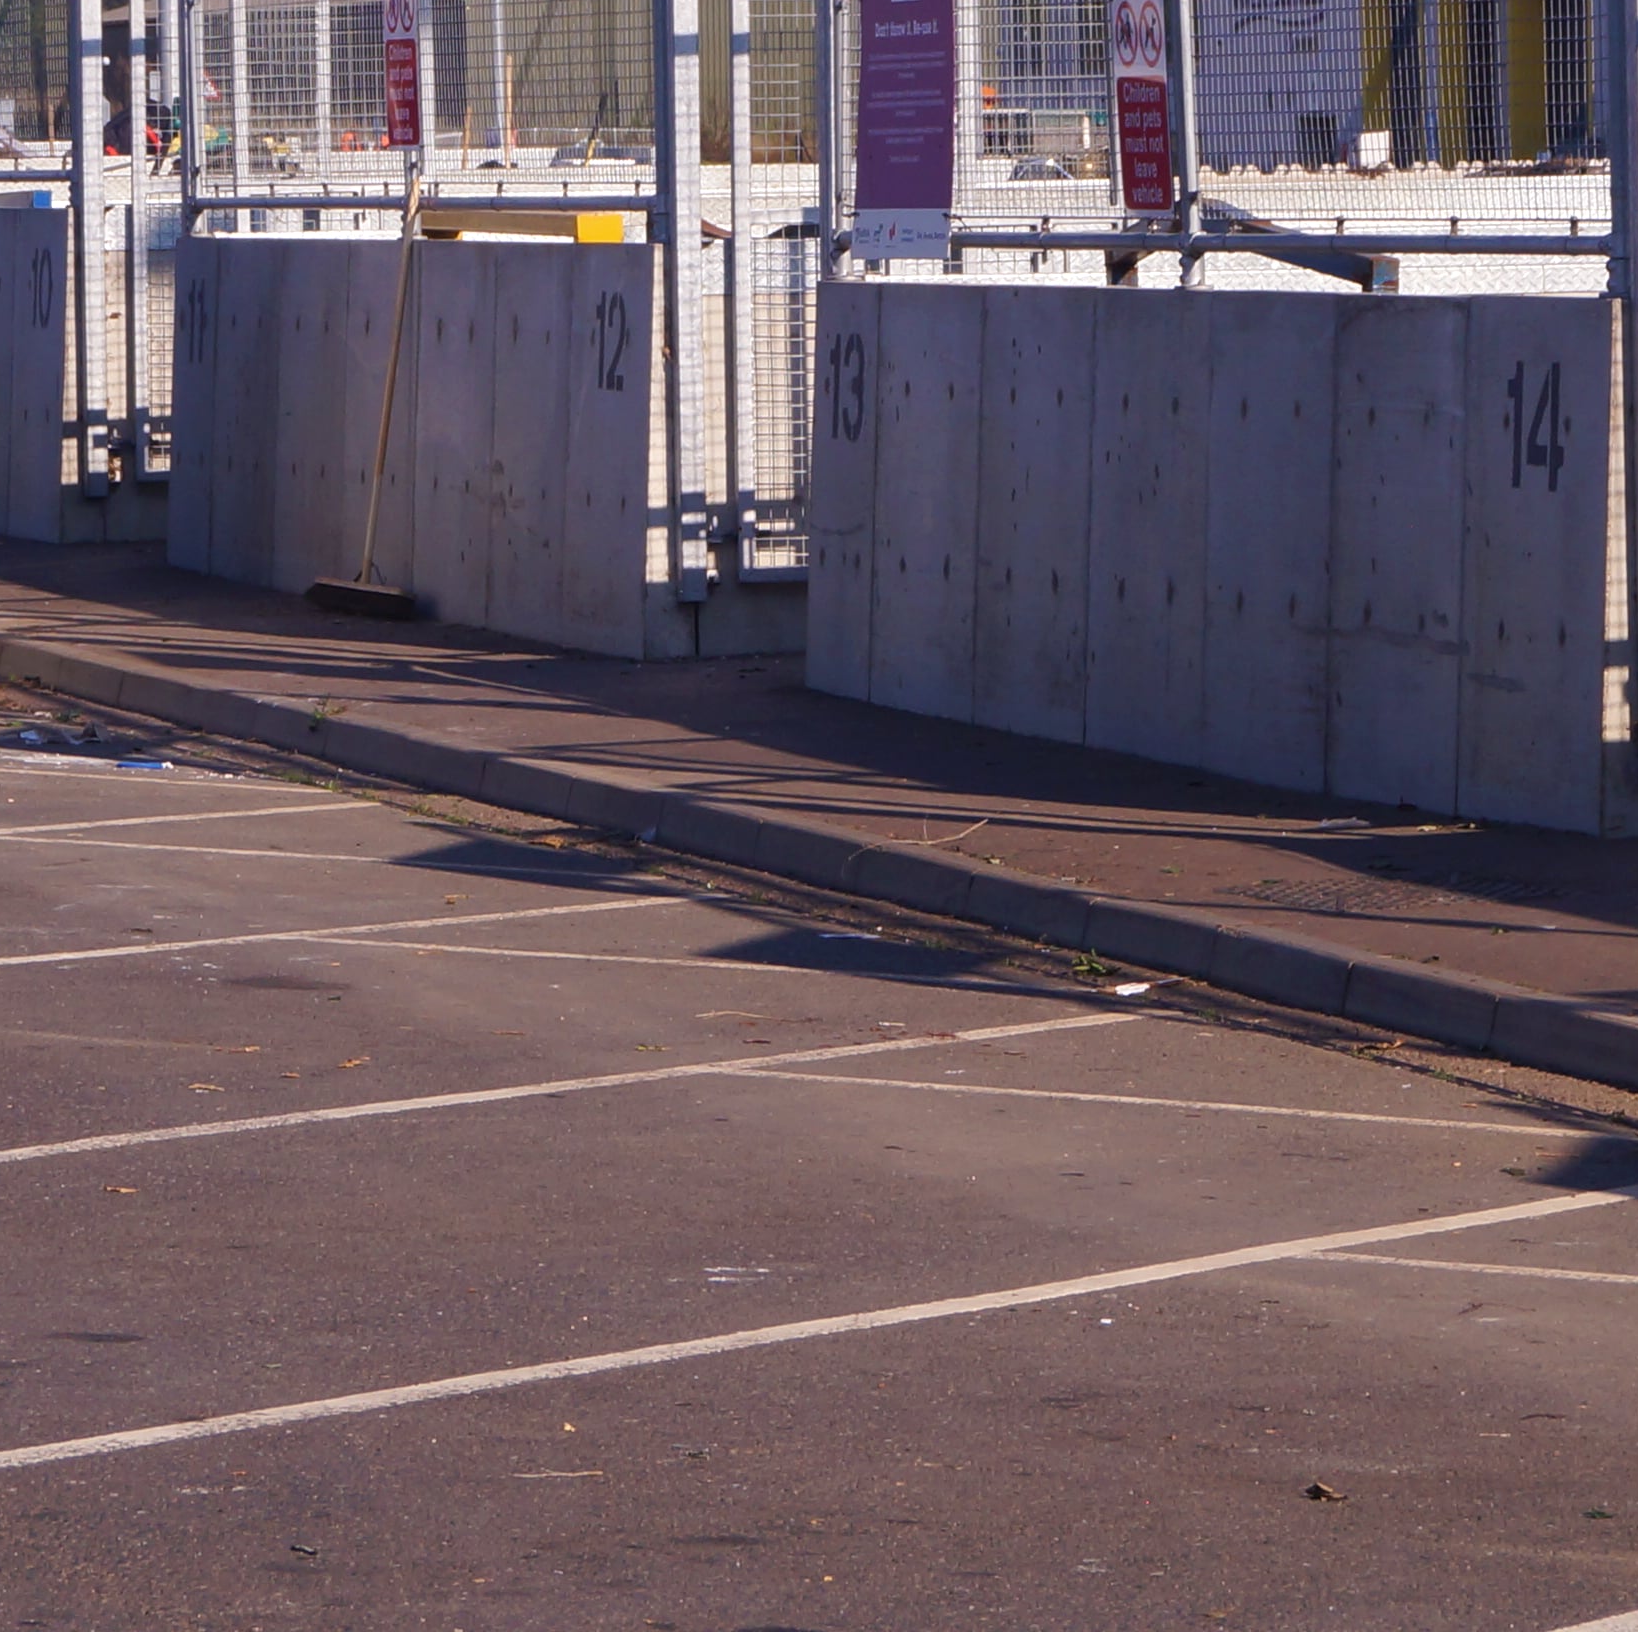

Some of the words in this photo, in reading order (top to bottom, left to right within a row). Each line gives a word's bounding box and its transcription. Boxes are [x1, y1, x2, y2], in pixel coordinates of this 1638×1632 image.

[1124, 81, 1161, 103] Children
[1124, 107, 1141, 128] and
[1142, 111, 1162, 131] pets
[1125, 133, 1148, 152] must
[1149, 134, 1165, 153] not
[1132, 183, 1163, 203] vehicle
[1134, 157, 1158, 178] leave
[31, 247, 53, 328] 10
[188, 278, 206, 364] 11
[596, 290, 627, 392] 12
[829, 332, 865, 444] 13
[1507, 360, 1565, 493] 14
